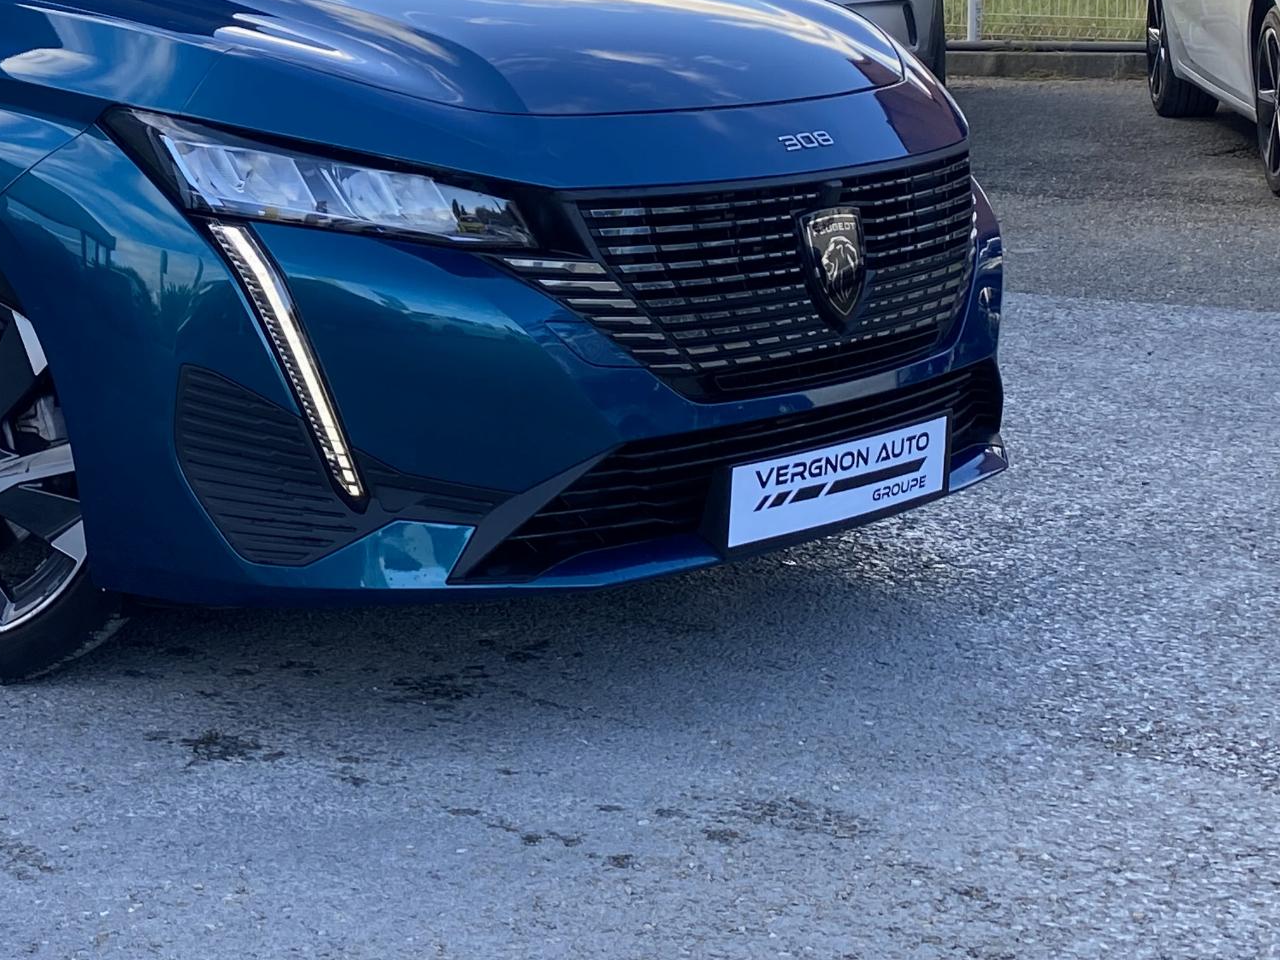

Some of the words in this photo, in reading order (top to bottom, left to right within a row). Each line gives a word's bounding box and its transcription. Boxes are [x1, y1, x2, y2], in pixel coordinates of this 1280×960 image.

[778, 130, 835, 151] 308
[755, 447, 870, 489] VERGNON
[875, 431, 930, 464] AUTO
[872, 474, 927, 501] GROUPE
